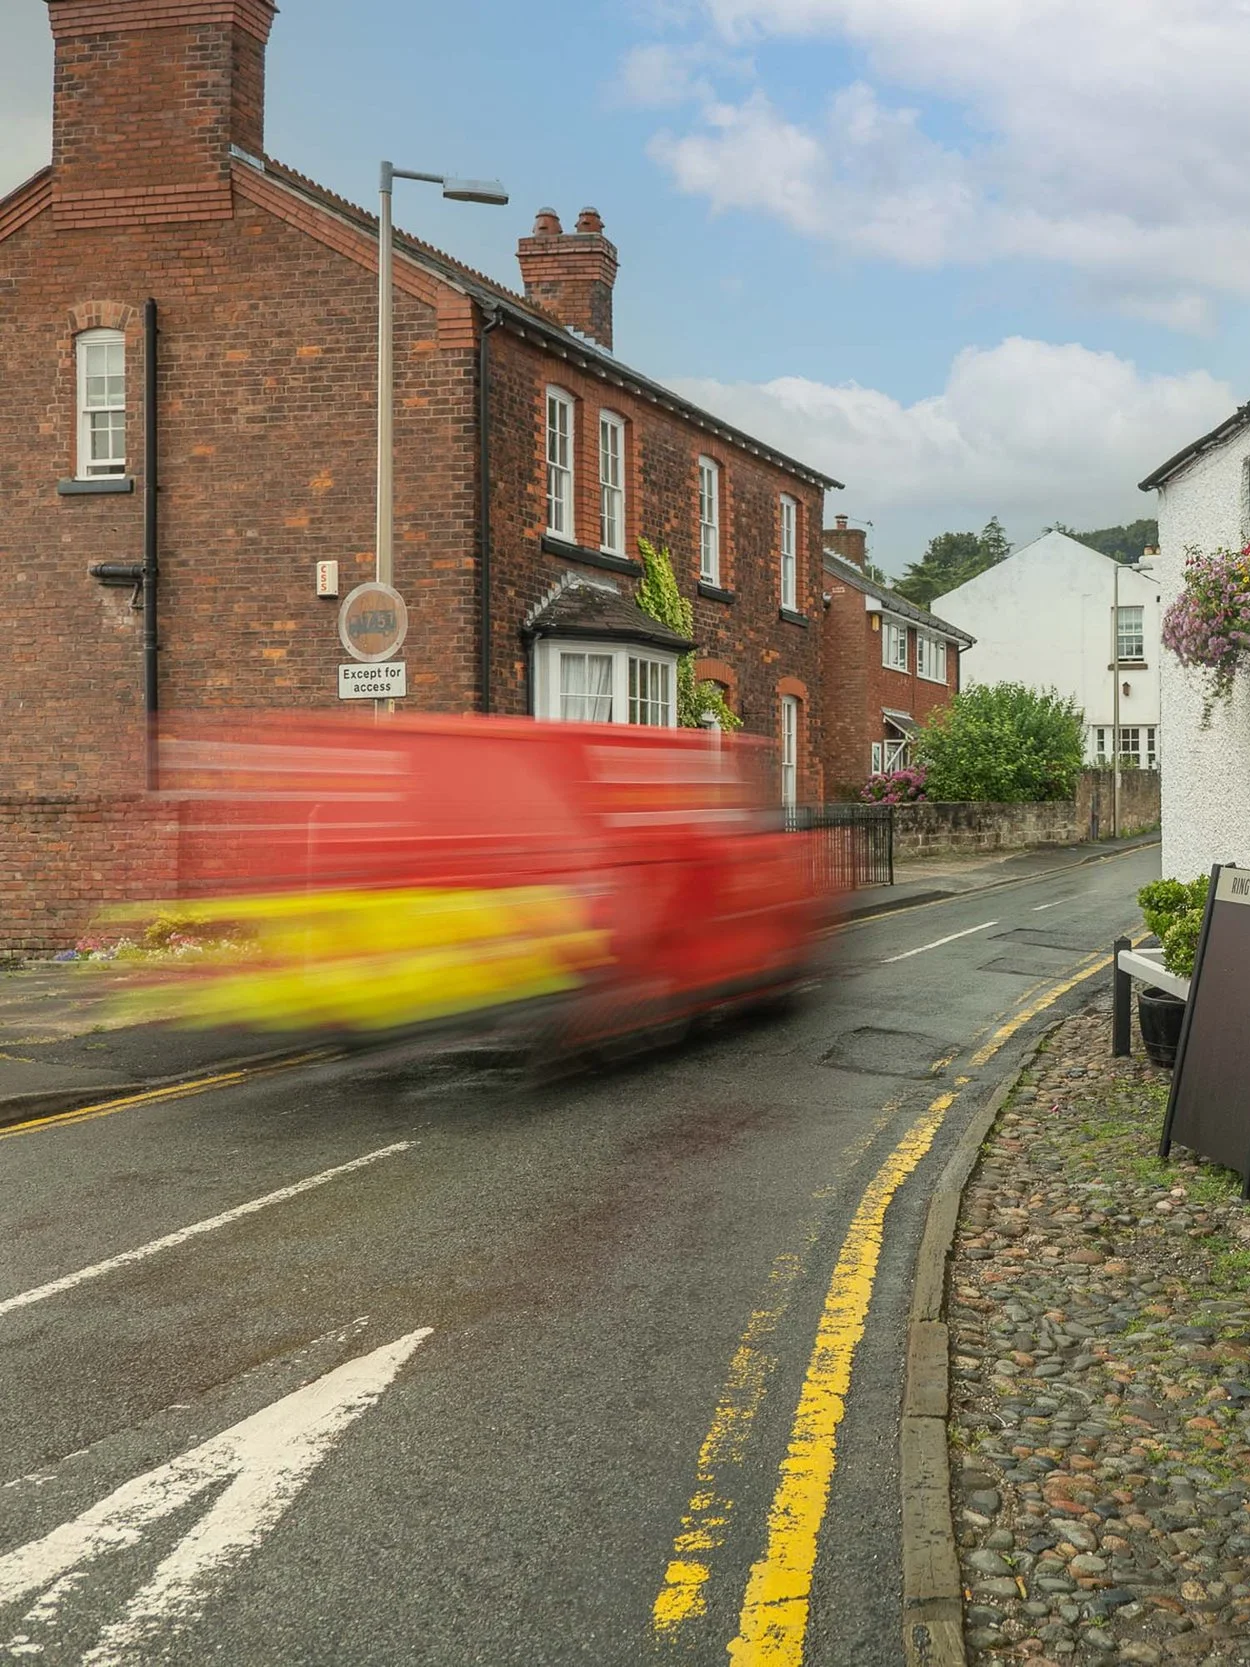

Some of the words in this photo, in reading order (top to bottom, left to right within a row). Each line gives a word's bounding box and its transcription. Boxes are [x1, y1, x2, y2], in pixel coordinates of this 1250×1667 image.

[343, 668, 382, 681] Except
[385, 667, 402, 678] for
[354, 682, 391, 693] access
[1231, 877, 1250, 896] RING
